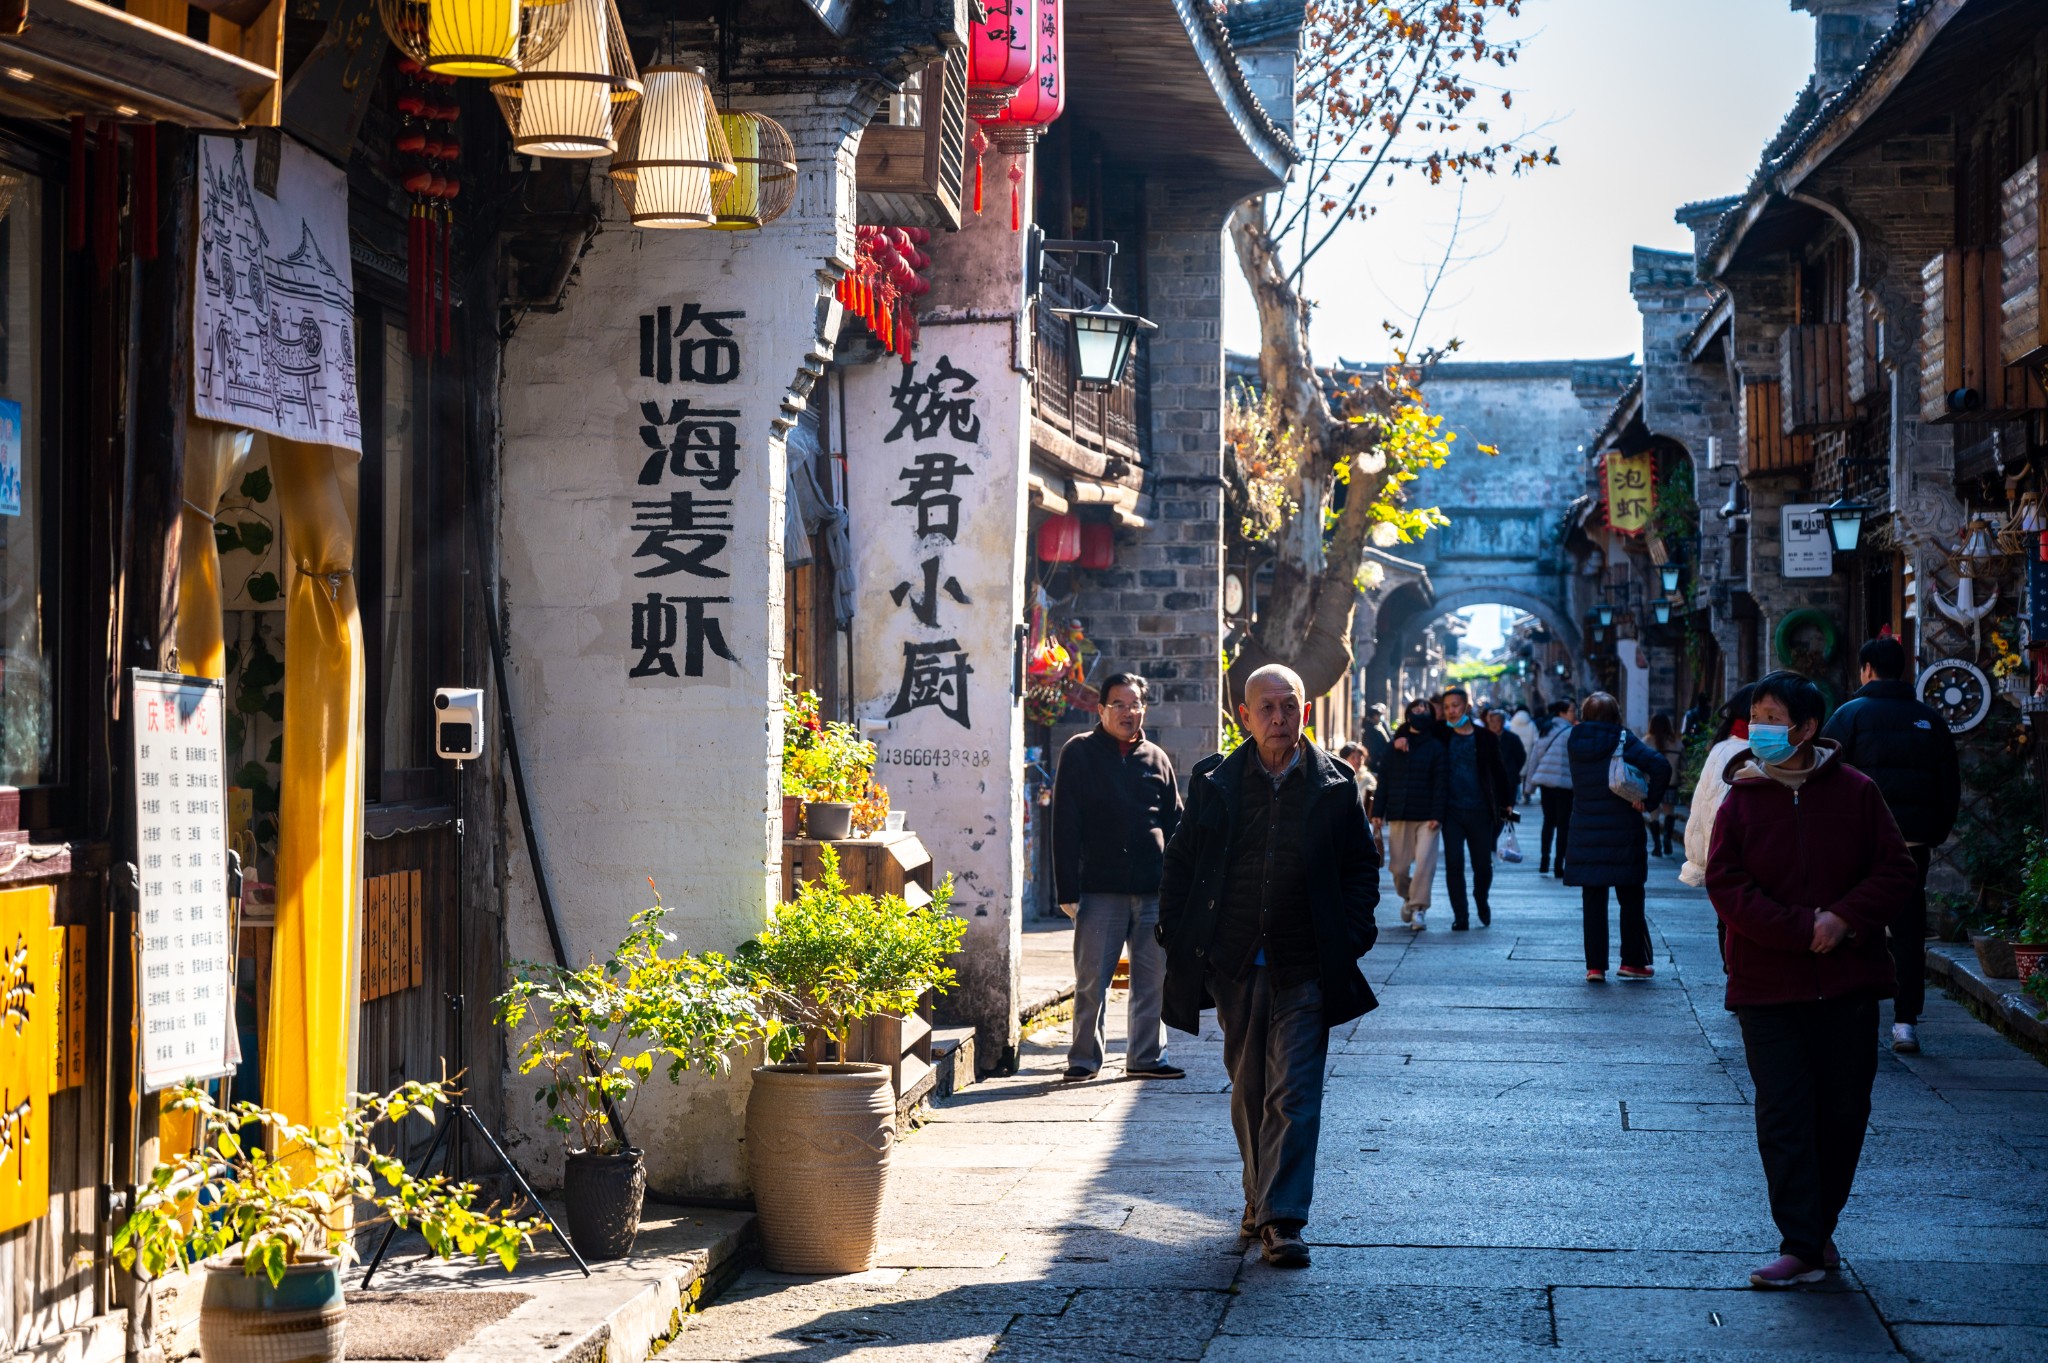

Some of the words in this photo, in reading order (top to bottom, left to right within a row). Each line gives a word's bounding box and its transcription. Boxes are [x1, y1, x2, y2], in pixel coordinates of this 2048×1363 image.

[629, 302, 746, 678] 临海麦虾
[884, 355, 980, 729] 婉君小厨
[1614, 468, 1647, 518] 泡虾
